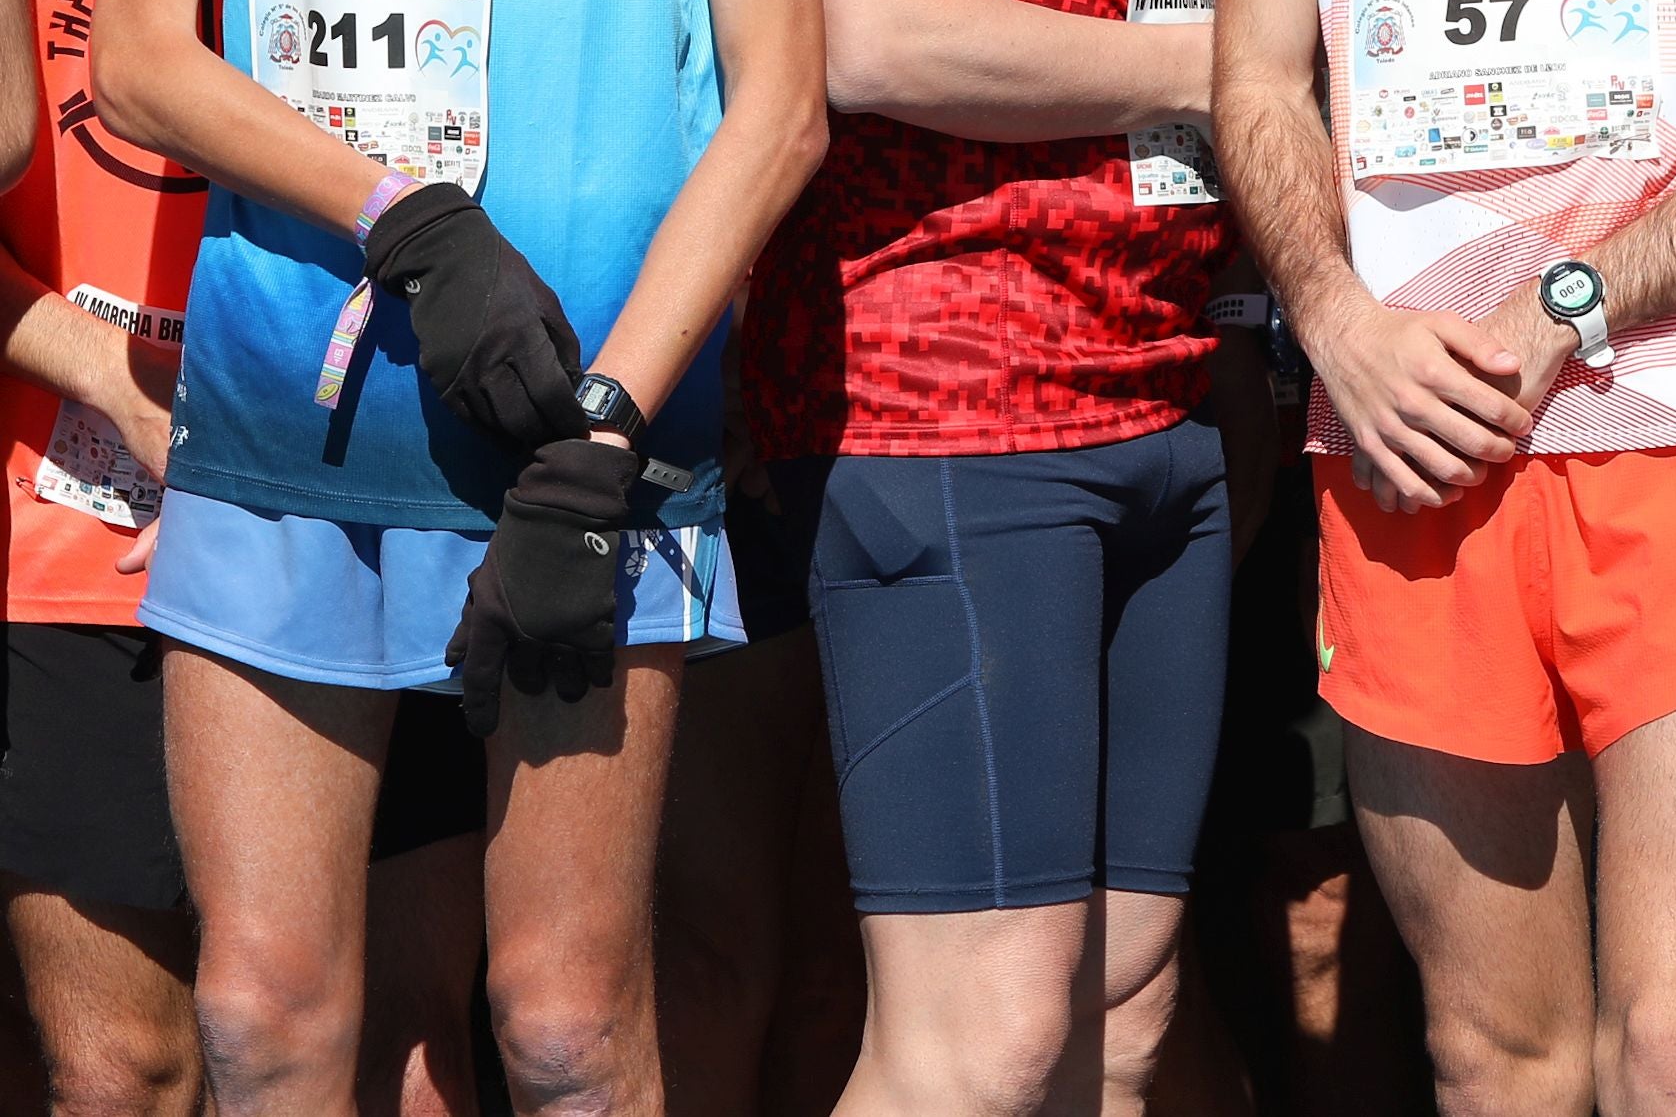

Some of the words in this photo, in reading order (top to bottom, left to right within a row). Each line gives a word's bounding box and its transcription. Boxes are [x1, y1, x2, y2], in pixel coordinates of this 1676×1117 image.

[308, 9, 405, 69] 211
[1475, 66, 1522, 76] SANCHEZ
[89, 297, 152, 339] MARCHA
